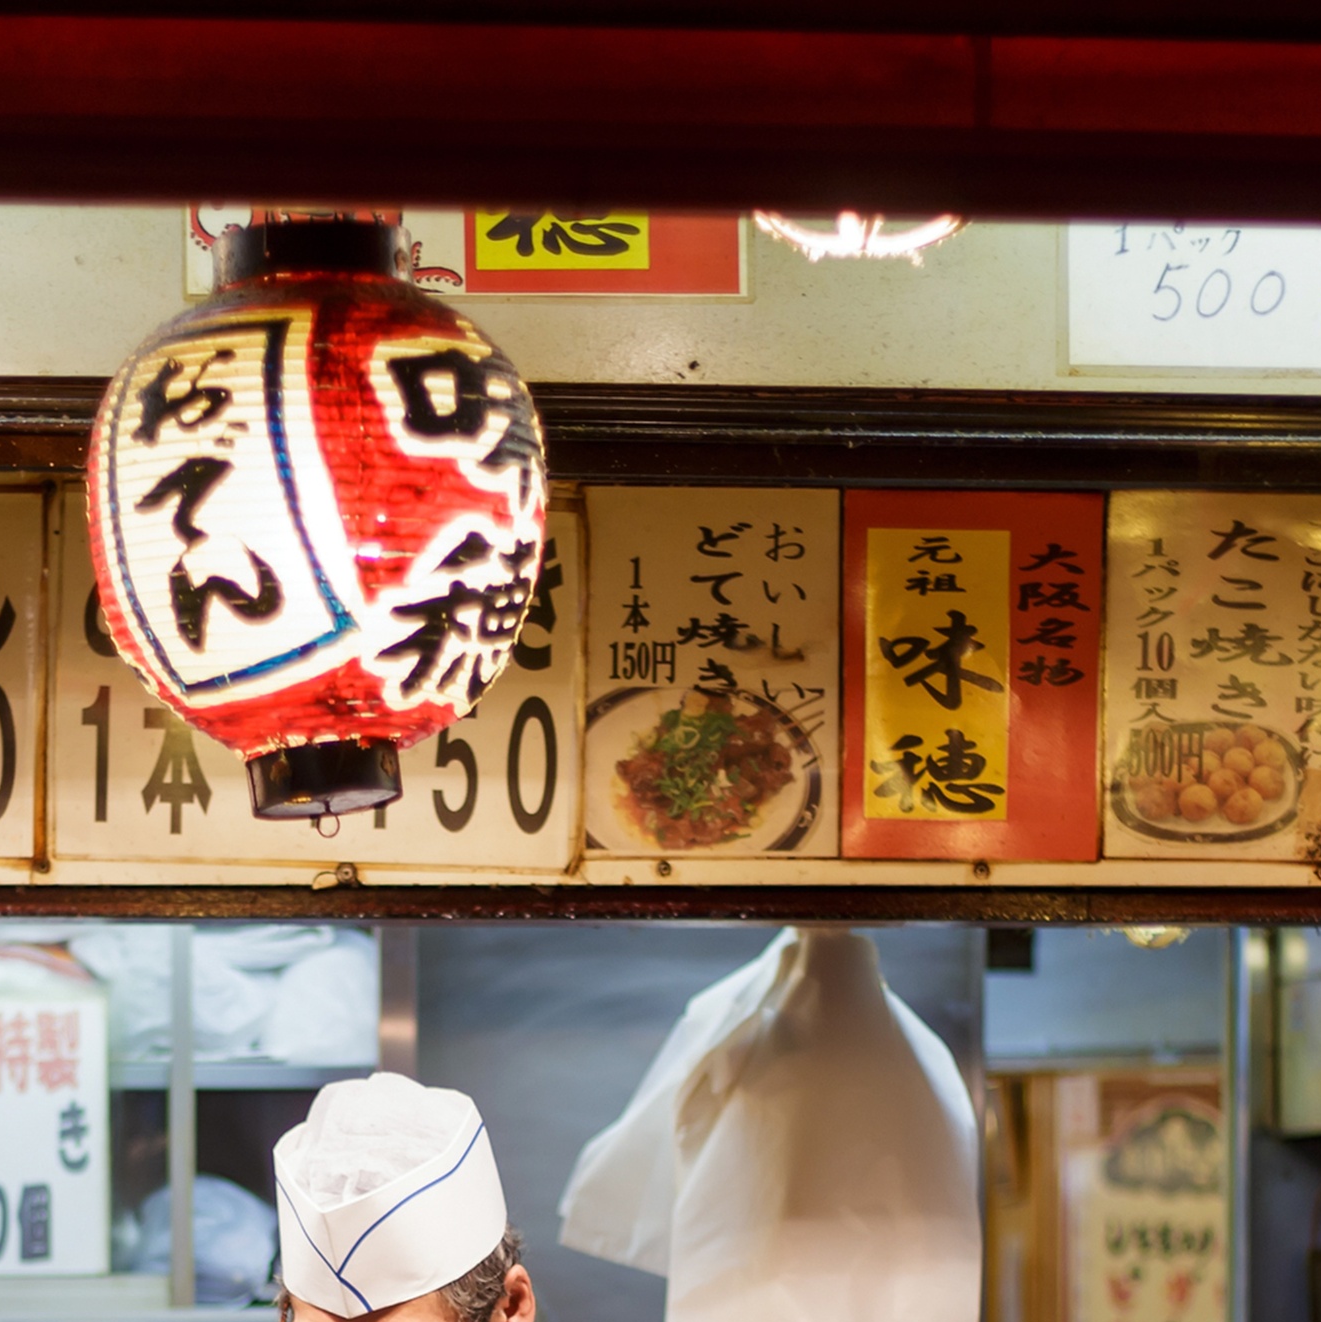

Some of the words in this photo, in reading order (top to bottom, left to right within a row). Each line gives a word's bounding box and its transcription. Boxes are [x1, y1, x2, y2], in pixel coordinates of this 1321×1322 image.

[1151, 262, 1286, 322] 500
[132, 349, 283, 654] おでん
[608, 641, 676, 684] 150円
[677, 522, 766, 697] どて焼き
[761, 522, 806, 700] おいしい
[1016, 543, 1091, 687] 大阪名物
[1189, 519, 1295, 720] たこ焼き
